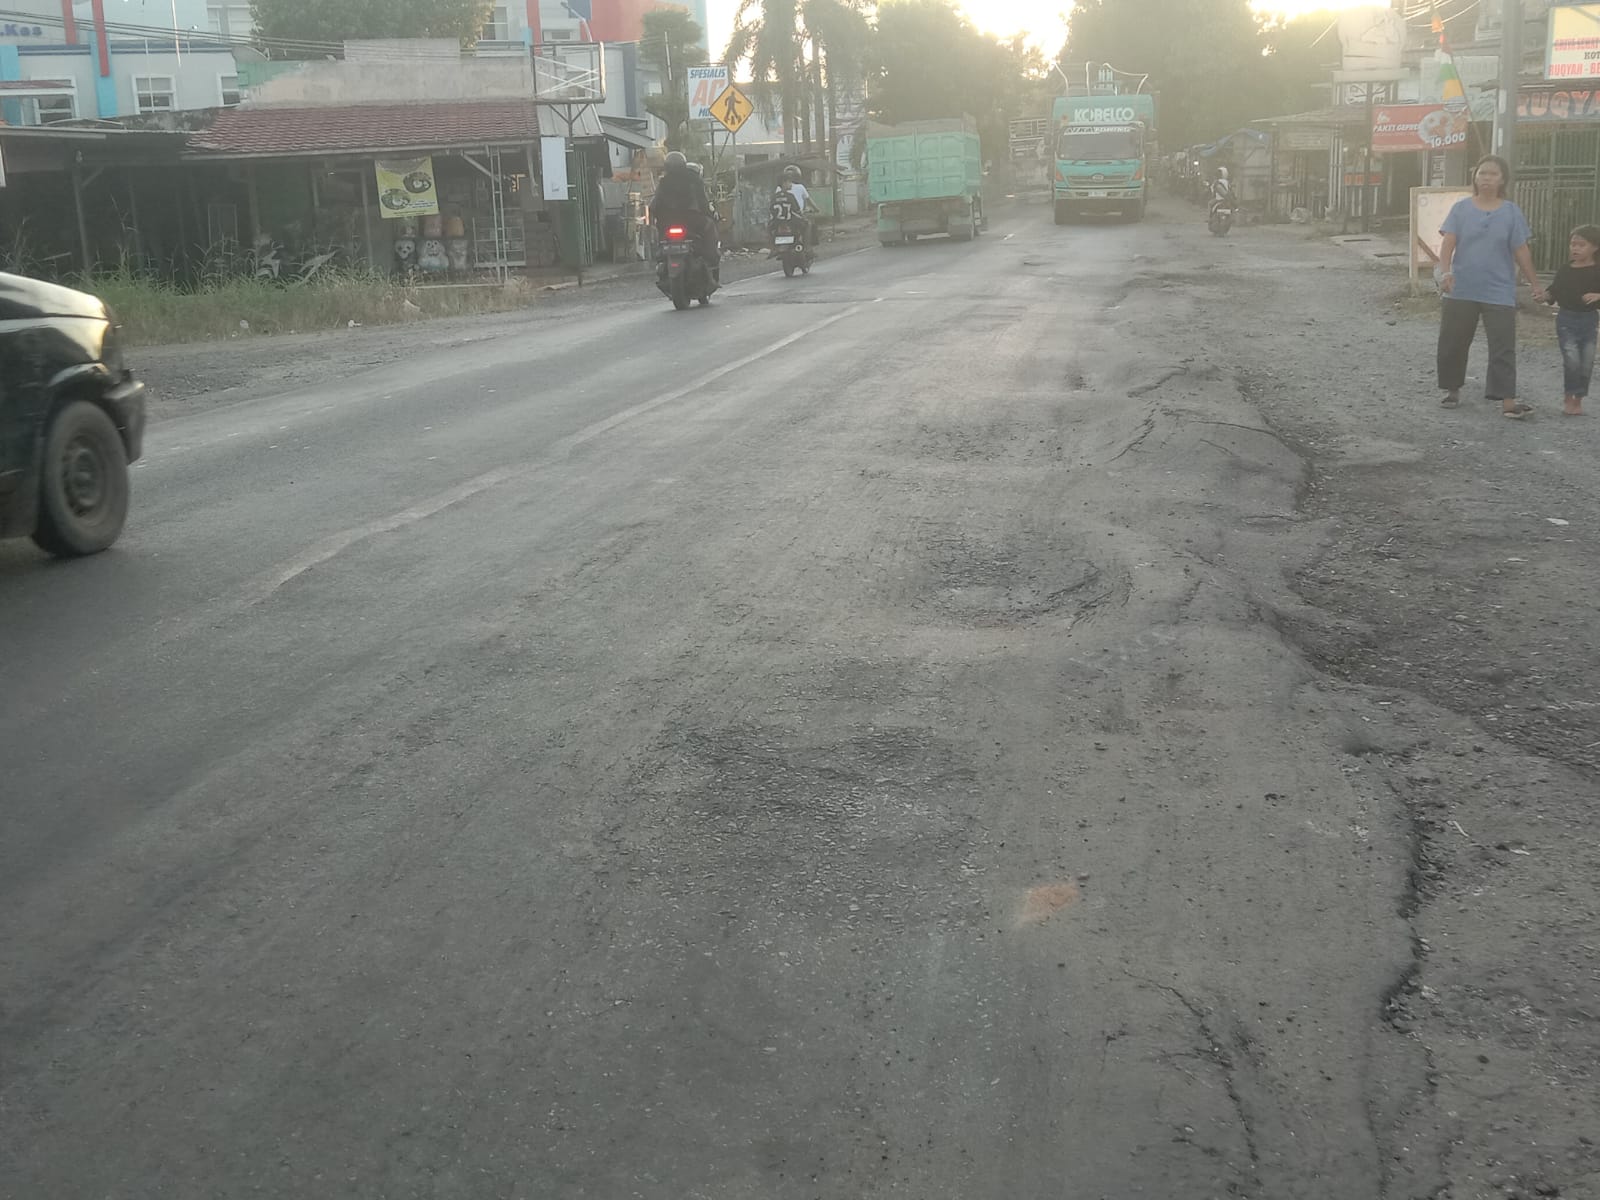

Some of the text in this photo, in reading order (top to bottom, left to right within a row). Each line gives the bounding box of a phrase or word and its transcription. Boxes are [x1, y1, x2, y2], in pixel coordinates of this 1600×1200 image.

[690, 68, 726, 79] SPESIALIS
[691, 79, 726, 106] AC
[1074, 107, 1135, 121] KOBELCO
[1430, 132, 1466, 148] 10.000
[773, 203, 791, 220] 27
